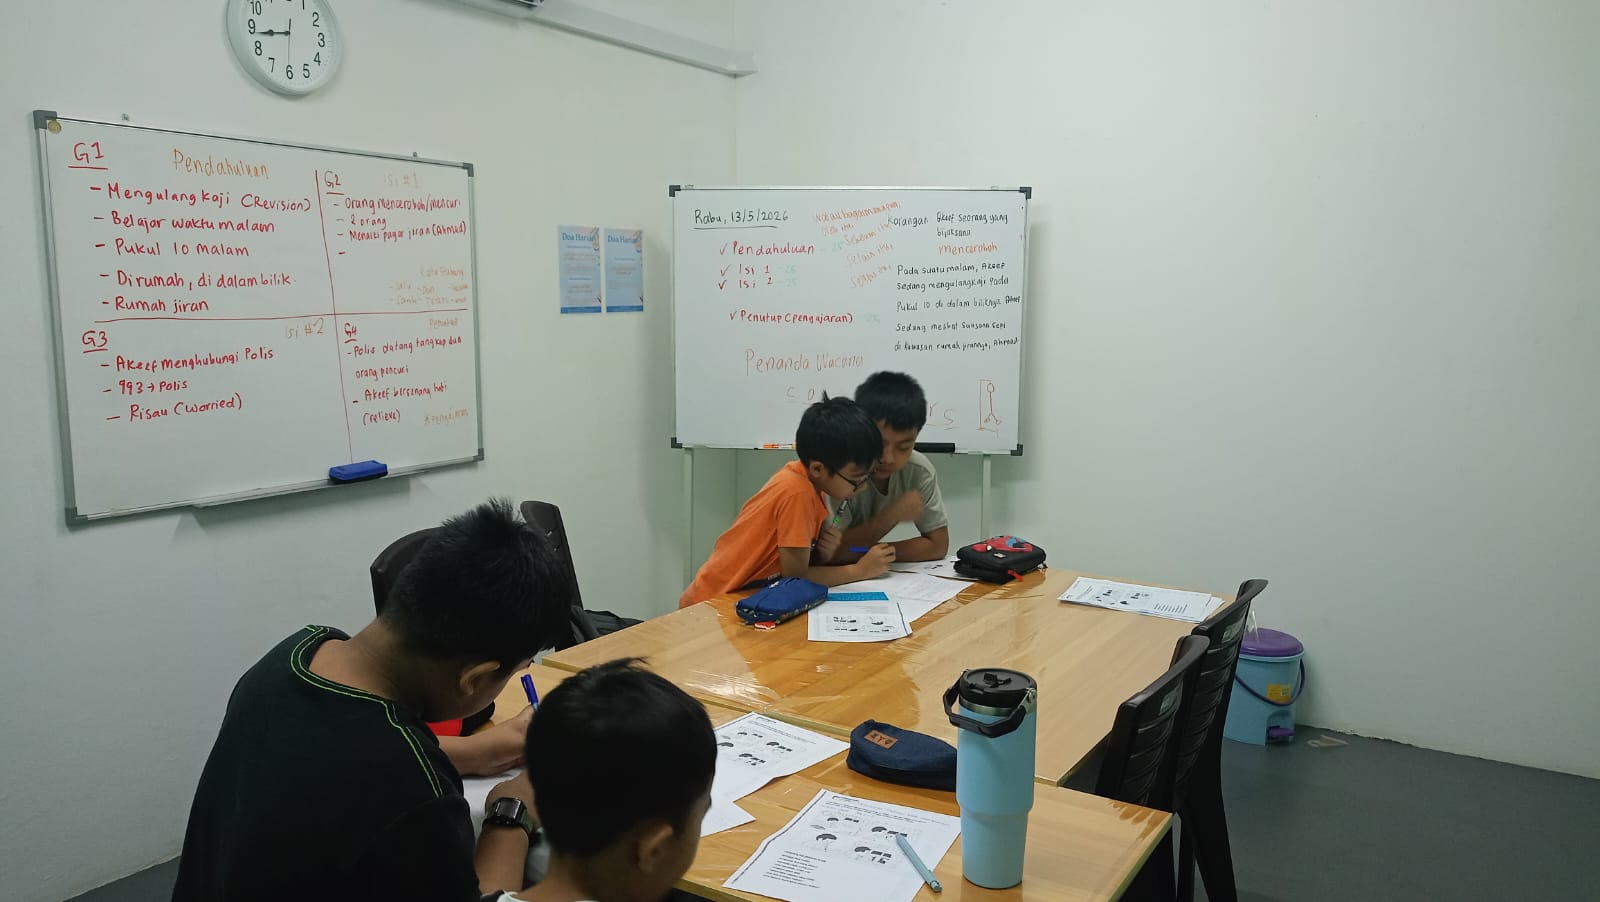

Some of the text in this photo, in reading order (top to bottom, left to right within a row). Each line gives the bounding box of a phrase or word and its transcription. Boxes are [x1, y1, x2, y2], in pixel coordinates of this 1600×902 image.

[250, 1, 261, 15] 10
[248, 18, 256, 34] 9
[312, 12, 320, 27] 2
[318, 33, 325, 47] 3
[255, 40, 262, 56] 8
[268, 57, 275, 72] 7
[313, 52, 321, 66] 4
[286, 65, 293, 79] 6
[302, 64, 310, 78] 5
[74, 142, 104, 163] G1
[173, 148, 269, 179] Pendahuluan
[324, 171, 341, 188] G2
[108, 182, 196, 205] Mengulang
[112, 211, 275, 233] Belajar waktu malam
[351, 214, 386, 230] 2 orang
[731, 209, 788, 223] 13/5/2026
[115, 238, 160, 256] Pukul
[173, 242, 188, 256] 10
[732, 241, 814, 256] Pendahuluan
[898, 265, 918, 275] Pada
[115, 296, 209, 313] Rumah jiran
[740, 310, 782, 323] Penutup
[82, 331, 108, 348] G3
[245, 347, 273, 360] Polis
[383, 341, 413, 354] datang
[745, 349, 810, 376] Penanda
[356, 369, 378, 381] orang
[130, 404, 168, 422] Risau
